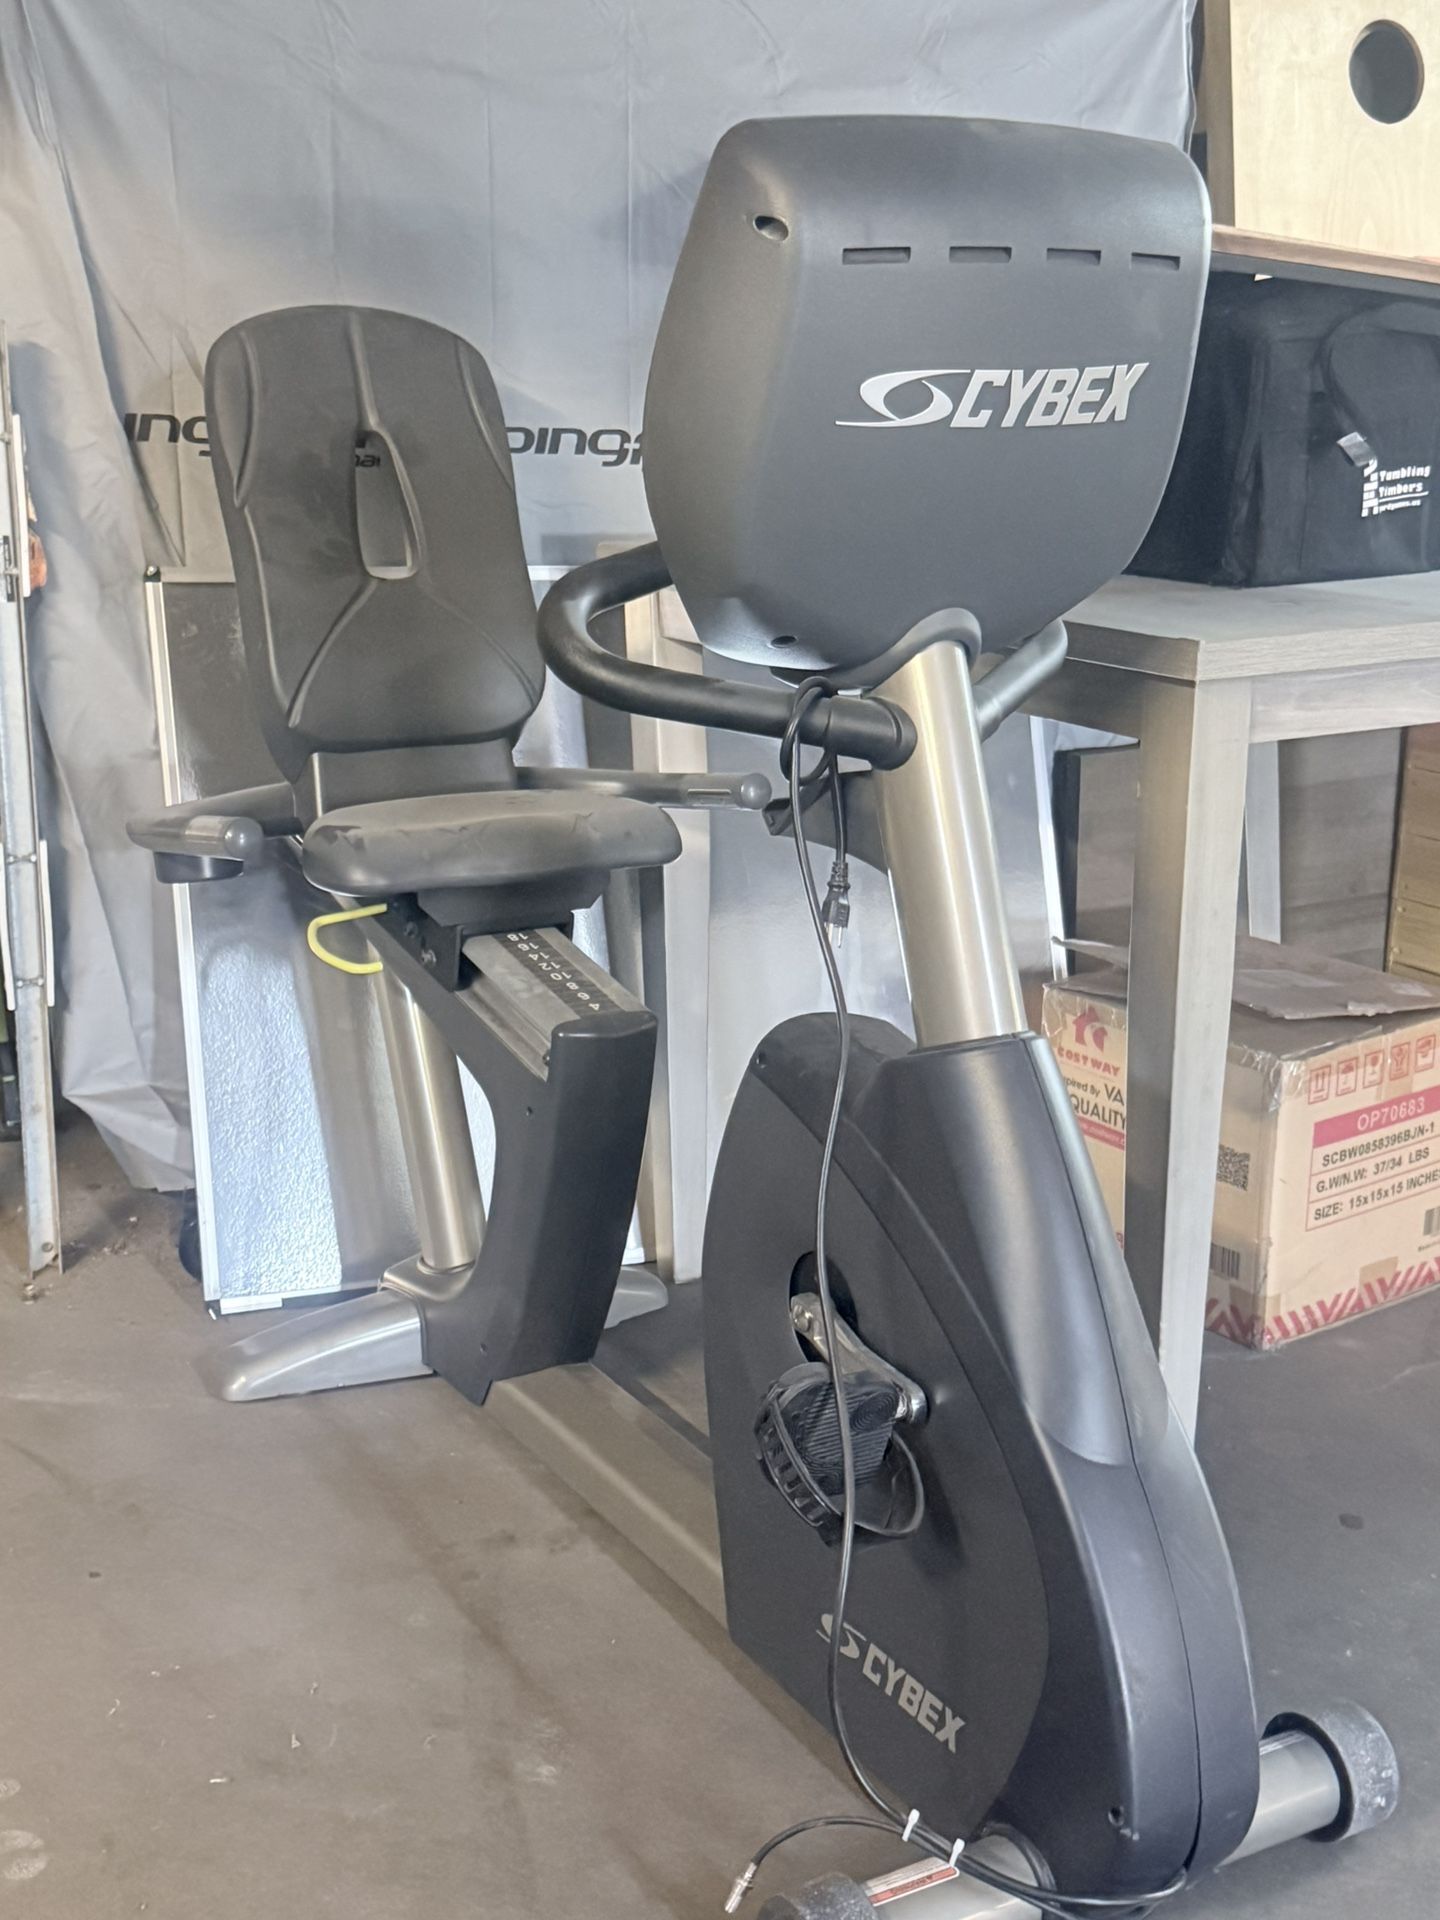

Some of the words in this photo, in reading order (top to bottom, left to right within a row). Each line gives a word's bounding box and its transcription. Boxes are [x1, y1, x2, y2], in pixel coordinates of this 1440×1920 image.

[950, 362, 1150, 428] CYBEX
[1379, 465, 1431, 482] Tumbling
[1378, 482, 1424, 498] Timbers
[507, 932, 528, 941] 18
[517, 942, 539, 951] 16
[528, 951, 550, 961] 14
[538, 961, 561, 971] 12
[550, 971, 572, 981] 10
[565, 981, 579, 990] 8
[577, 992, 590, 1000] 6
[588, 1003, 600, 1011] 4
[1063, 1075, 1089, 1093] pired
[1070, 1093, 1126, 1131] QUALITY
[1372, 1154, 1403, 1176] 37/34
[1407, 1146, 1431, 1165] LBS
[1313, 1200, 1344, 1222] SIZE:
[1348, 1180, 1404, 1210] 15x15x15
[862, 1642, 967, 1754] CYBEX
